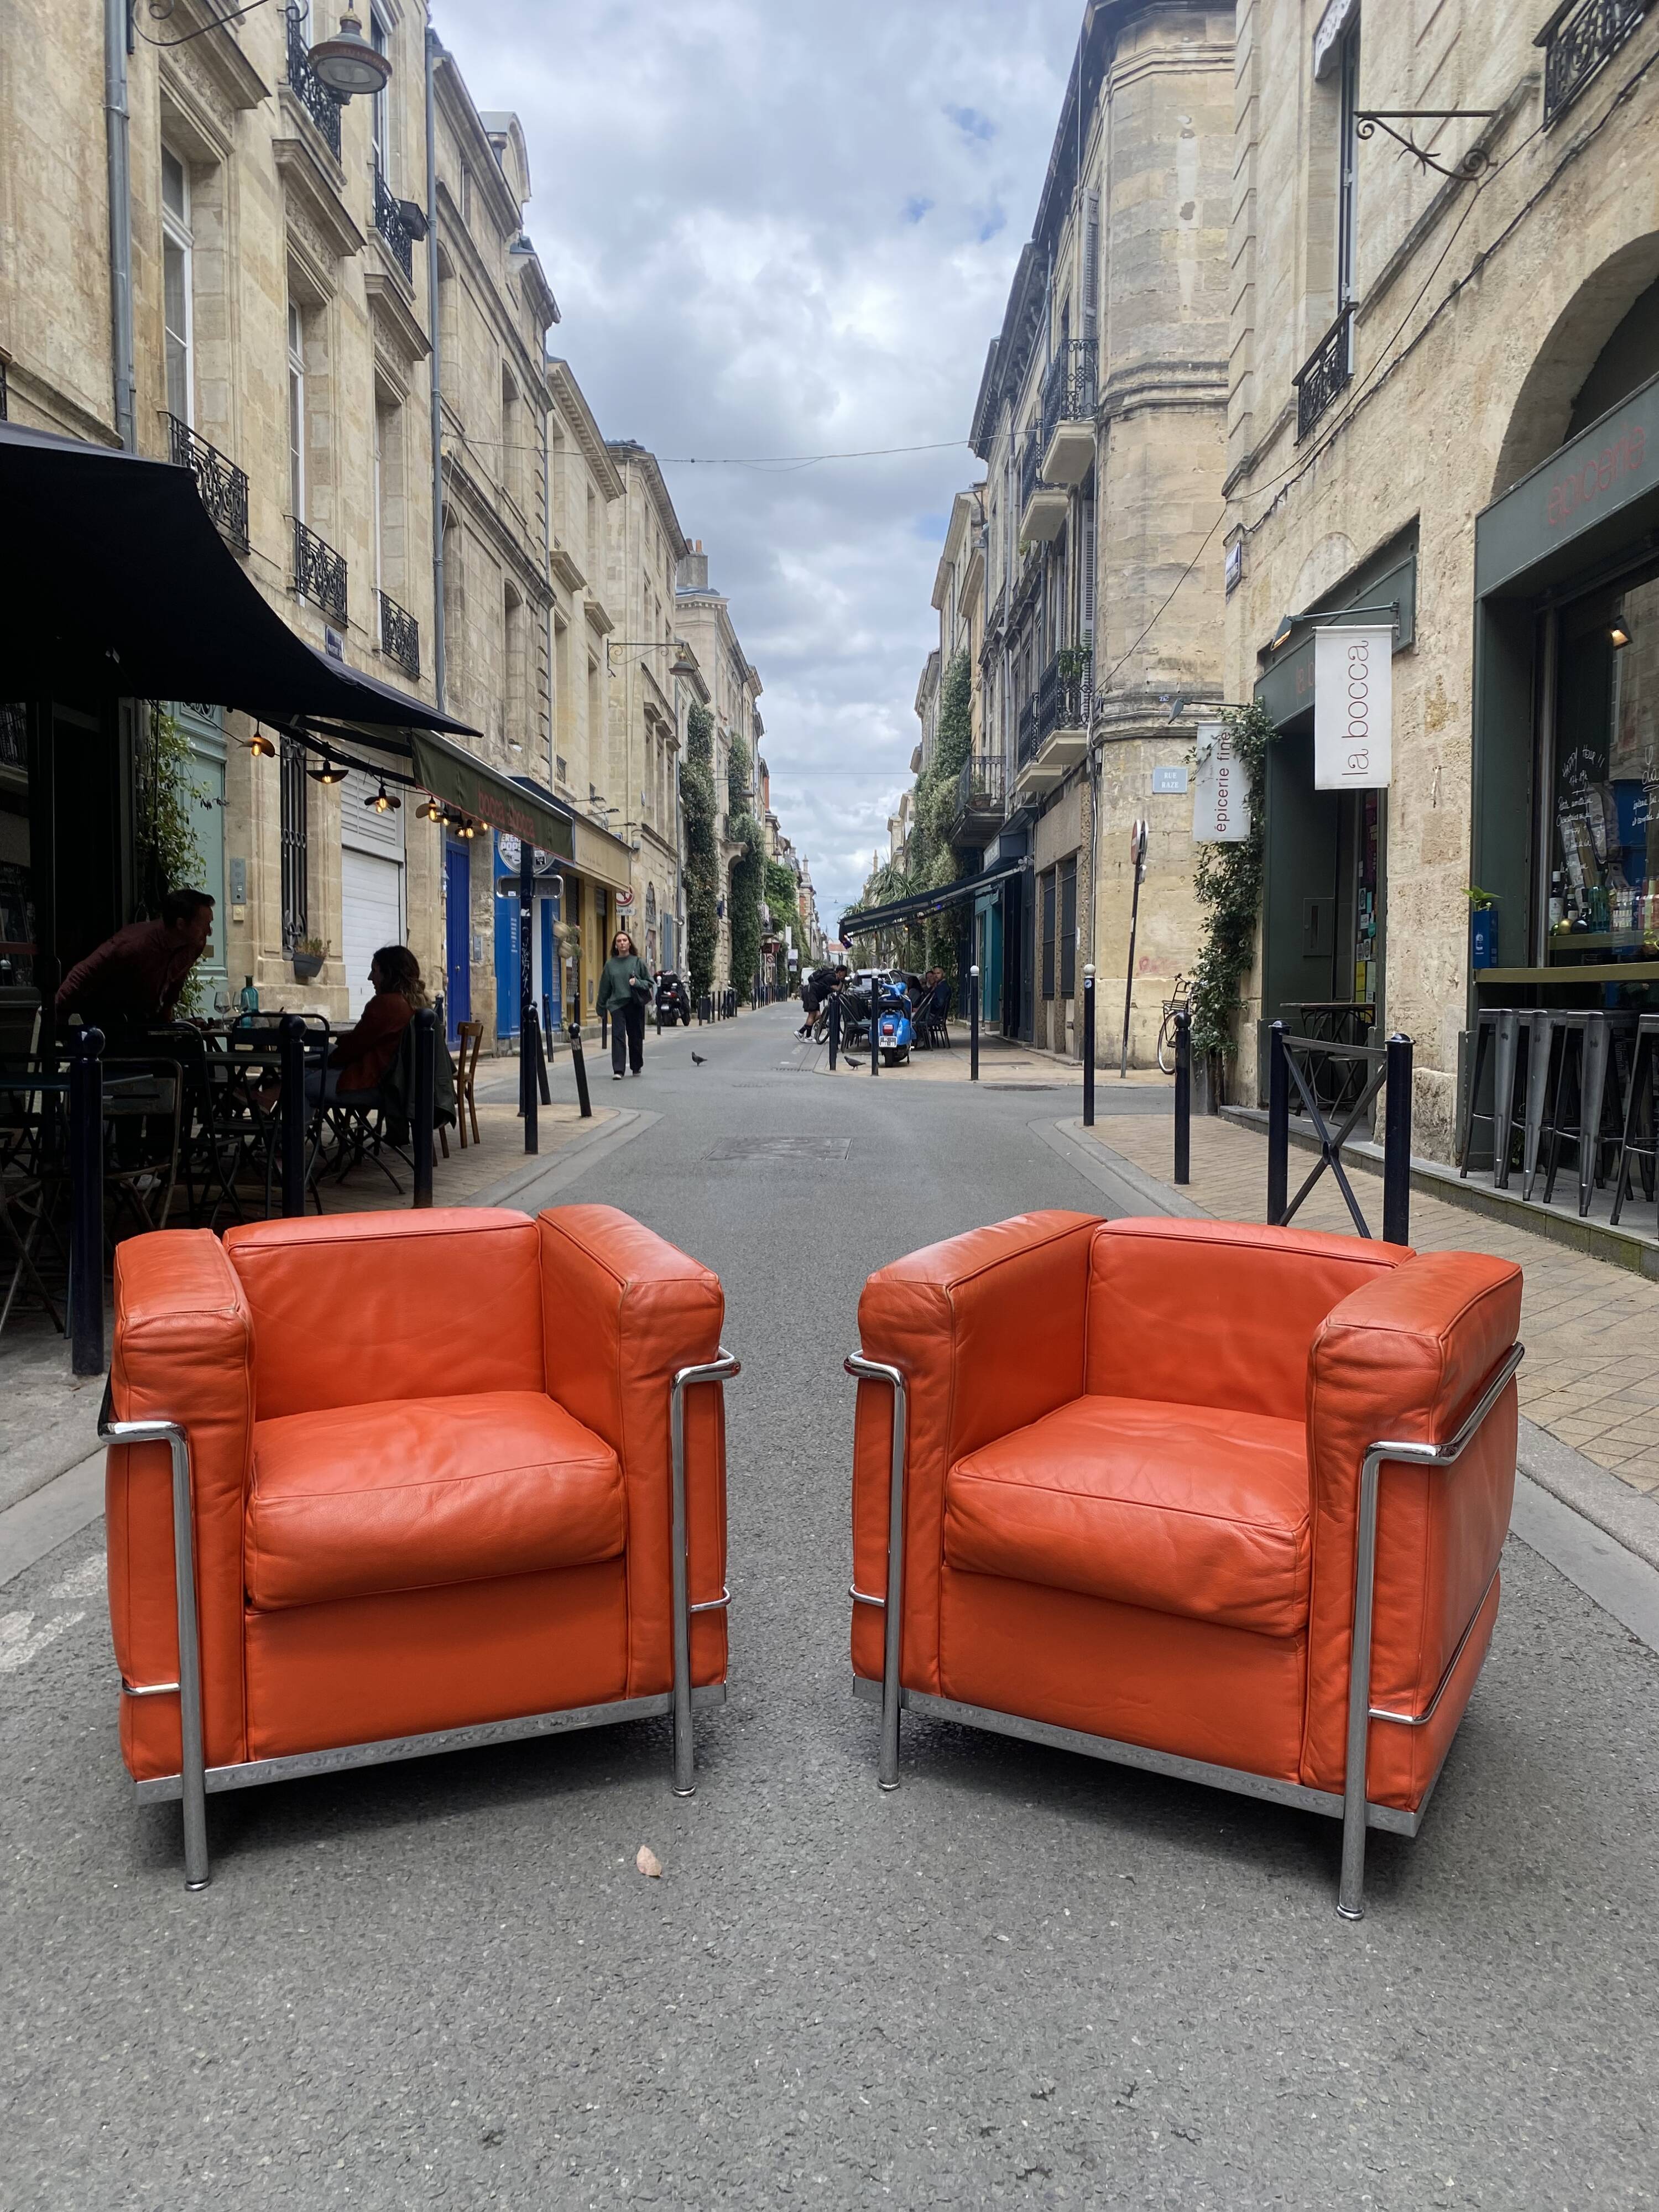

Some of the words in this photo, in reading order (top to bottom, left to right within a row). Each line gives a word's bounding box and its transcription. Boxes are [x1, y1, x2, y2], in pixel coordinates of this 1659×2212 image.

[1548, 424, 1646, 531] épicerie
[1342, 640, 1369, 738] bocca
[1217, 732, 1231, 761] fine
[1342, 748, 1369, 775] la
[1214, 768, 1230, 832] épicerie
